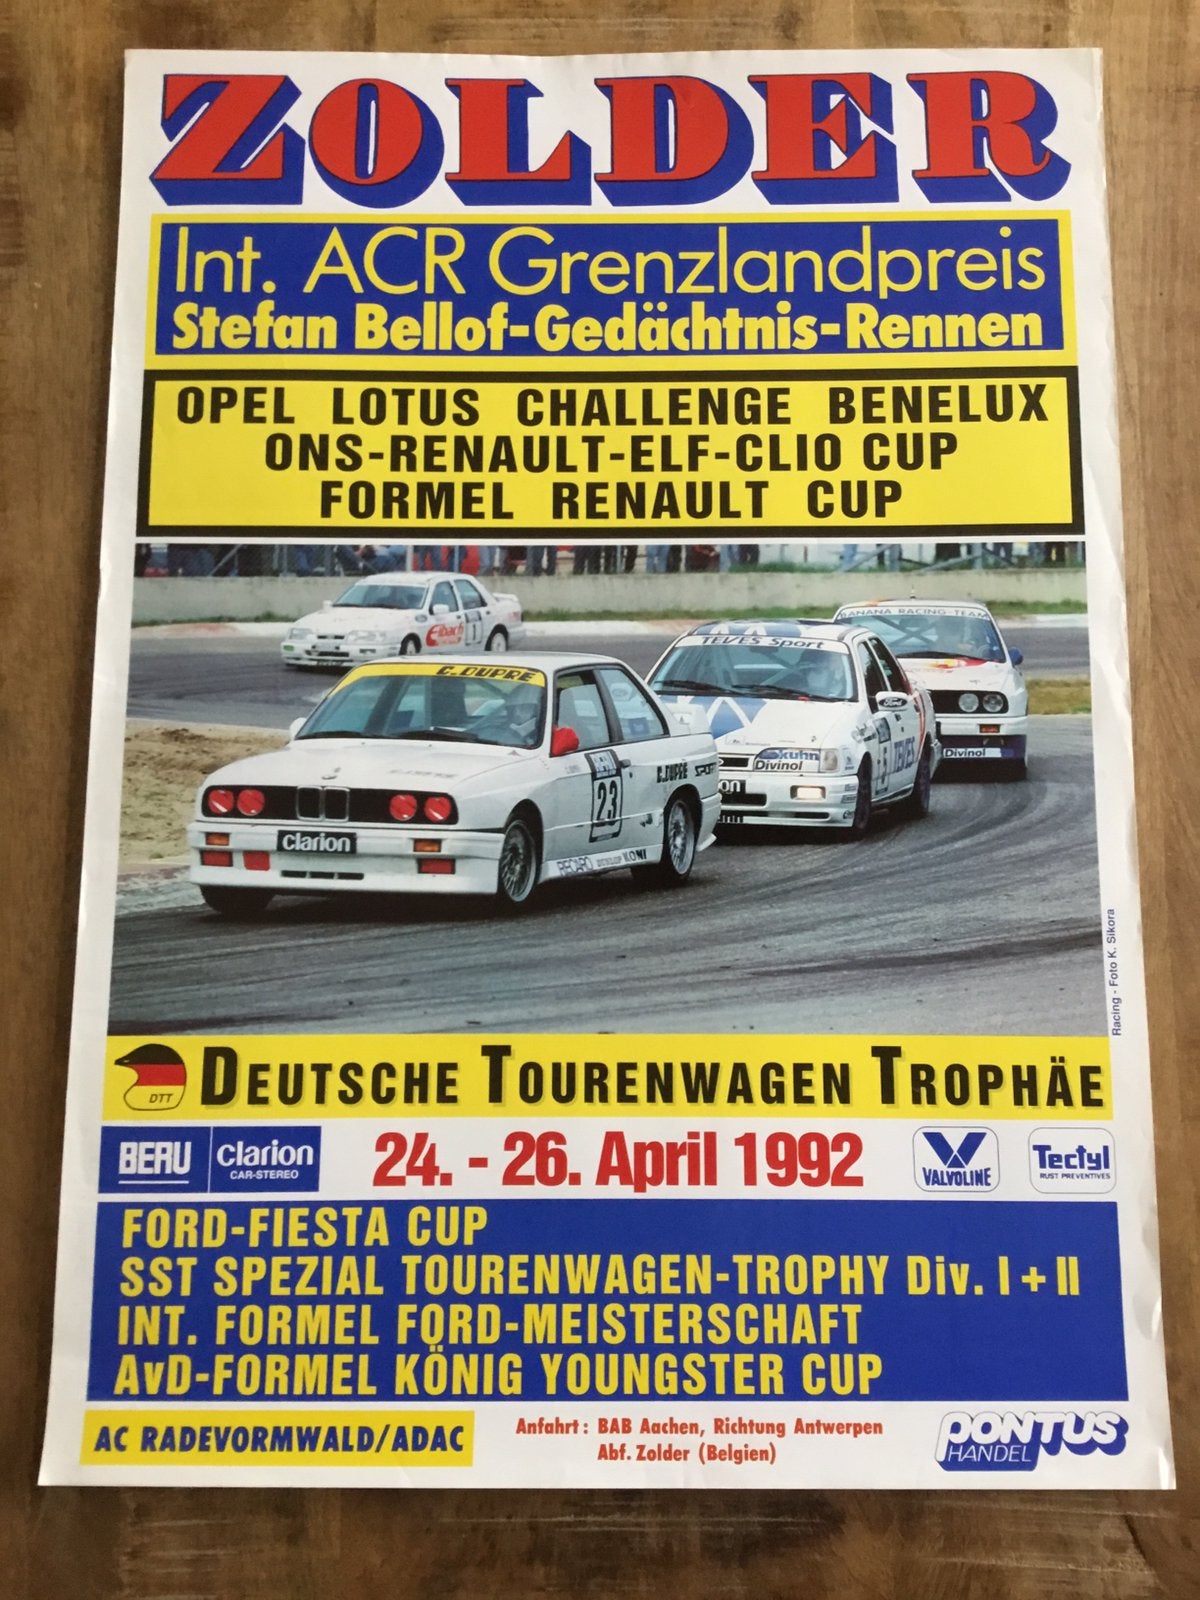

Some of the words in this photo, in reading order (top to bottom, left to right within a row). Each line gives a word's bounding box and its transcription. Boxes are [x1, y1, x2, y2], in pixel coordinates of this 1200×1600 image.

[149, 72, 1072, 209] ZOLDER
[175, 226, 276, 293] Int.
[302, 226, 466, 294] ACR
[488, 225, 1046, 299] Grenzlandpreis
[172, 300, 337, 350] Stefan
[355, 301, 1043, 352] Bellof-Gedächtnis-Rennen
[177, 386, 296, 425] OPEL
[331, 387, 480, 427] LOTUS
[516, 387, 791, 427] CHALLENGE
[828, 384, 1049, 425] BENELUX
[265, 432, 841, 473] ONS-RENAULT-ELF-CLIO
[863, 432, 958, 471] CUP
[320, 480, 514, 520] FORMEL
[552, 480, 769, 520] RENAULT
[807, 480, 902, 519] CUP
[898, 607, 947, 616] RACING
[702, 636, 762, 646] TEVES
[768, 637, 824, 649] Sport
[436, 665, 537, 682] C.DUPRE
[754, 760, 804, 771] Divinol
[779, 749, 821, 761] kuhn
[943, 748, 987, 758] Divinol
[594, 779, 619, 828] 23
[622, 848, 648, 863] KONI
[1106, 908, 1117, 944] Sikora
[1108, 961, 1119, 987] Foto
[1111, 997, 1122, 1036] Racing
[201, 1046, 458, 1106] DEUTSCHE
[481, 1044, 851, 1105] TOURENWAGEN
[871, 1045, 1104, 1107] TROPHÄE
[148, 1093, 174, 1104] DTT
[118, 1141, 192, 1175] BERU
[372, 1131, 453, 1187] 24.
[502, 1131, 581, 1187] 26.
[595, 1130, 718, 1194] April
[734, 1131, 864, 1188] 1992
[1032, 1144, 1110, 1170] Tectyl
[229, 1169, 299, 1180] CAR-STEREO
[922, 1167, 991, 1186] VALVOLINE
[123, 1207, 389, 1249] FORD-FIESTA
[407, 1206, 487, 1247] CUP
[120, 1256, 197, 1297] SST
[213, 1255, 384, 1297] SPEZIAL
[401, 1253, 889, 1296] TOURENWAGEN-TROPHY
[907, 1255, 983, 1295] Div.
[998, 1256, 1010, 1295] I
[1021, 1267, 1045, 1292] +
[118, 1305, 197, 1345] INT.
[216, 1304, 379, 1346] FORMEL
[397, 1303, 862, 1346] FORD-MEISTERSCHAFT
[114, 1354, 377, 1396] AvD-FORMEL
[396, 1345, 522, 1396] KÖNIG
[541, 1352, 784, 1396] YOUNGSTER
[802, 1353, 882, 1396] CUP
[94, 1426, 129, 1452] AC
[141, 1425, 464, 1453] RADEVORMWALD/ADAC
[597, 1417, 632, 1434] BAB
[640, 1417, 705, 1437] Aachen,
[713, 1417, 786, 1438] Richtung
[794, 1418, 883, 1437] Antwerpen
[934, 1411, 1130, 1463] PONTUS
[597, 1443, 632, 1461] Abf.
[636, 1444, 689, 1461] Zolder
[699, 1442, 776, 1465] (Belgien)
[948, 1445, 1032, 1462] HANDEL
